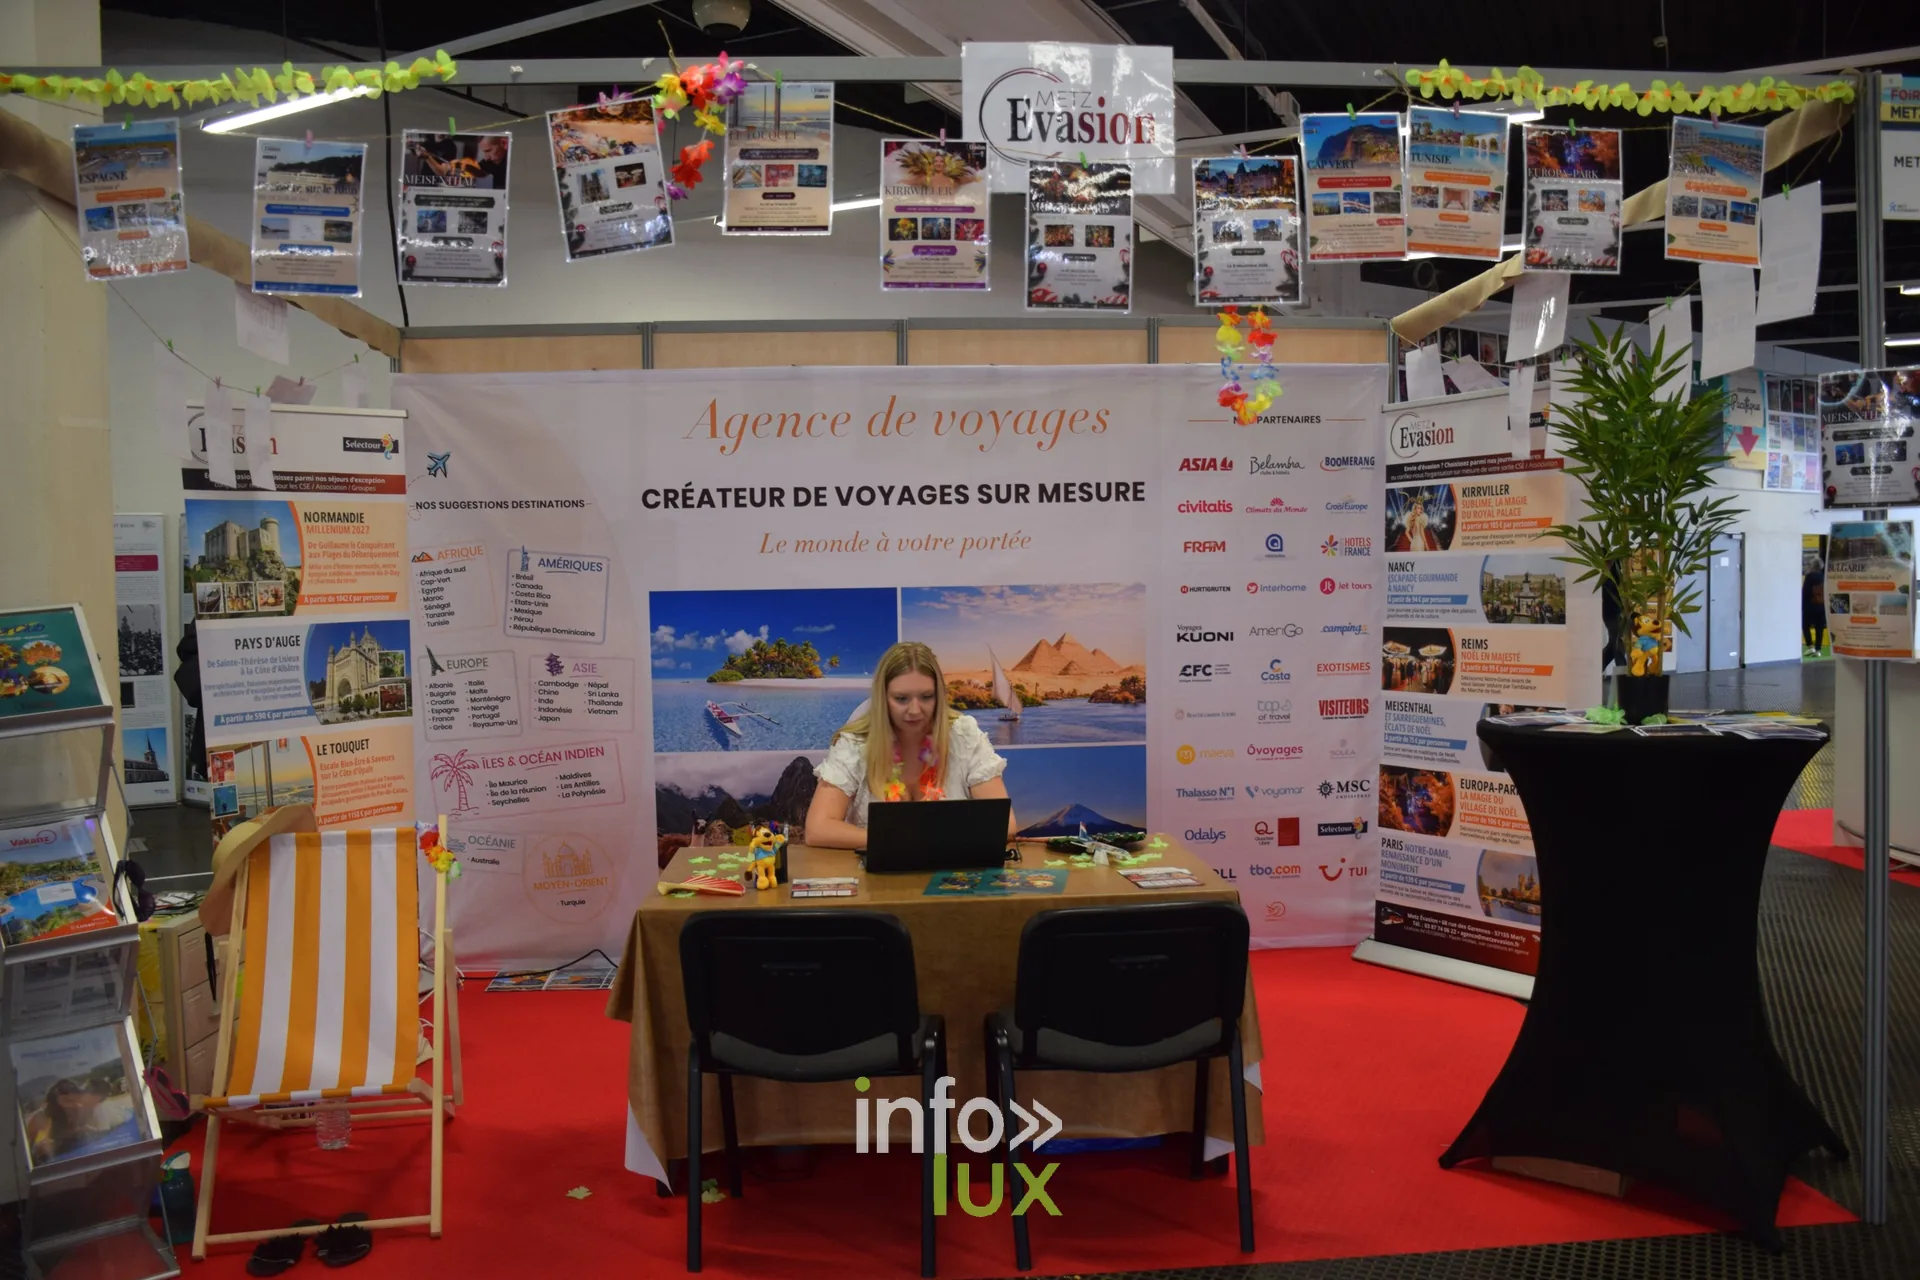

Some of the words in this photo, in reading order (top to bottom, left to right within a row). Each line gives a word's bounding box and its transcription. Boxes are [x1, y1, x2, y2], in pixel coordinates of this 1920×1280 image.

[1036, 91, 1092, 108] METZ
[1890, 106, 1920, 119] MET
[1007, 96, 1155, 144] Evasion
[1331, 160, 1356, 168] VERT
[1412, 153, 1452, 164] TUNISIE
[79, 172, 128, 184] ESPAGNE
[1527, 168, 1598, 179] EUROPA-PARK
[404, 175, 477, 187] MEISENTHAL
[682, 398, 851, 455] Agence
[867, 396, 917, 437] de
[933, 406, 1110, 452] voyages
[1257, 416, 1321, 424] PARTENAIRES
[1400, 422, 1454, 449] Evasion
[346, 440, 381, 450] Selectour
[1179, 458, 1218, 471] ASIA
[1250, 454, 1305, 475] Belambra
[1325, 456, 1375, 466] BOOMERANG
[642, 482, 785, 509] CRÉATEUR
[794, 486, 827, 507] DE
[835, 484, 970, 506] VOYAGES
[977, 484, 1030, 504] SUR
[1038, 482, 1145, 503] MESURE
[1462, 484, 1510, 498] KIRRVILLER
[415, 502, 436, 510] NOS
[439, 500, 509, 510] SUGGESTIONS
[511, 500, 585, 509] DESTINATIONS
[1178, 500, 1233, 513] civitatis
[304, 512, 364, 523] NORMANDIE
[1462, 510, 1472, 520] DU
[1473, 509, 1495, 519] ROYAL
[1497, 507, 1521, 517] PALACE
[306, 525, 350, 534] MILLENIUM
[760, 533, 787, 554] Le
[795, 530, 869, 553] monde
[876, 534, 890, 552] à
[898, 534, 954, 552] votre
[960, 529, 1032, 558] portée
[1184, 541, 1226, 552] FRAM
[1344, 538, 1371, 546] HOTELS
[437, 546, 483, 562] AFRIQUE
[1344, 547, 1371, 556] FRANCE
[538, 557, 603, 572] AMÉRIQUES
[1388, 562, 1415, 572] NANCY
[420, 577, 451, 586] Cap-Vert
[1388, 574, 1417, 582] ESCAPADE
[1419, 573, 1458, 582] GOURMANDE
[422, 587, 444, 595] Egypte
[1260, 584, 1306, 592] Interhome
[515, 599, 548, 608] Etats-Unis
[426, 610, 455, 619] Tanzanie
[515, 608, 542, 616] Mexique
[427, 619, 449, 627] Tunisie
[513, 624, 551, 634] République
[552, 628, 595, 637] Dominicaine
[1177, 632, 1234, 642] KUONI
[234, 636, 262, 650] PAYS
[265, 636, 300, 648] D'AUGE
[1461, 638, 1488, 650] REIMS
[216, 656, 268, 667] Sainte-Thérèse
[1481, 652, 1490, 660] EN
[1492, 651, 1520, 663] MAJESTÉ
[446, 658, 488, 670] EUROPE
[572, 663, 598, 673] ASIE
[1317, 662, 1370, 672] EXOTISMES
[1261, 672, 1290, 681] Costa
[538, 680, 579, 689] Cambodge
[430, 690, 456, 698] Bulgarie
[470, 695, 510, 704] Monténégro
[431, 707, 459, 715] Espagne
[471, 704, 499, 712] Norvège
[1319, 699, 1369, 716] VISITEURS
[1385, 700, 1433, 714] MEISENTHAL
[472, 712, 500, 720] Portugal
[1385, 713, 1392, 721] ET
[1393, 714, 1446, 727] SARREGUEMINES,
[472, 719, 518, 729] Royaume-Uni
[317, 745, 327, 756] LE
[329, 739, 370, 754] TOUQUET
[482, 756, 504, 770] ÎLES
[508, 757, 516, 766] &
[520, 750, 562, 765] OCÉAN
[565, 747, 605, 760] INDIEN
[560, 772, 592, 781] Maldives
[574, 780, 600, 788] Antilles
[1336, 780, 1370, 792] MSC
[1176, 788, 1217, 798] Thalasso
[1460, 791, 1468, 800] LA
[1470, 792, 1492, 803] MAGIE
[1494, 795, 1504, 804] DU
[492, 796, 530, 807] Seychelles
[1460, 802, 1487, 813] VILLAGE
[1488, 806, 1496, 815] DE
[1320, 825, 1352, 834] Selectour
[10, 836, 49, 846] Vakanz
[1185, 828, 1226, 844] Odalys
[468, 835, 516, 849] OCÉANIE
[1381, 837, 1403, 851] PARIS
[471, 857, 500, 866] Australie
[1381, 850, 1425, 864] RENAISSANCE
[1425, 858, 1442, 867] D'UN
[1250, 864, 1301, 876] tbo.com
[1349, 867, 1367, 877] TUI
[1381, 860, 1419, 874] MONUMENT
[534, 877, 608, 890] MOYEN-ORIENT
